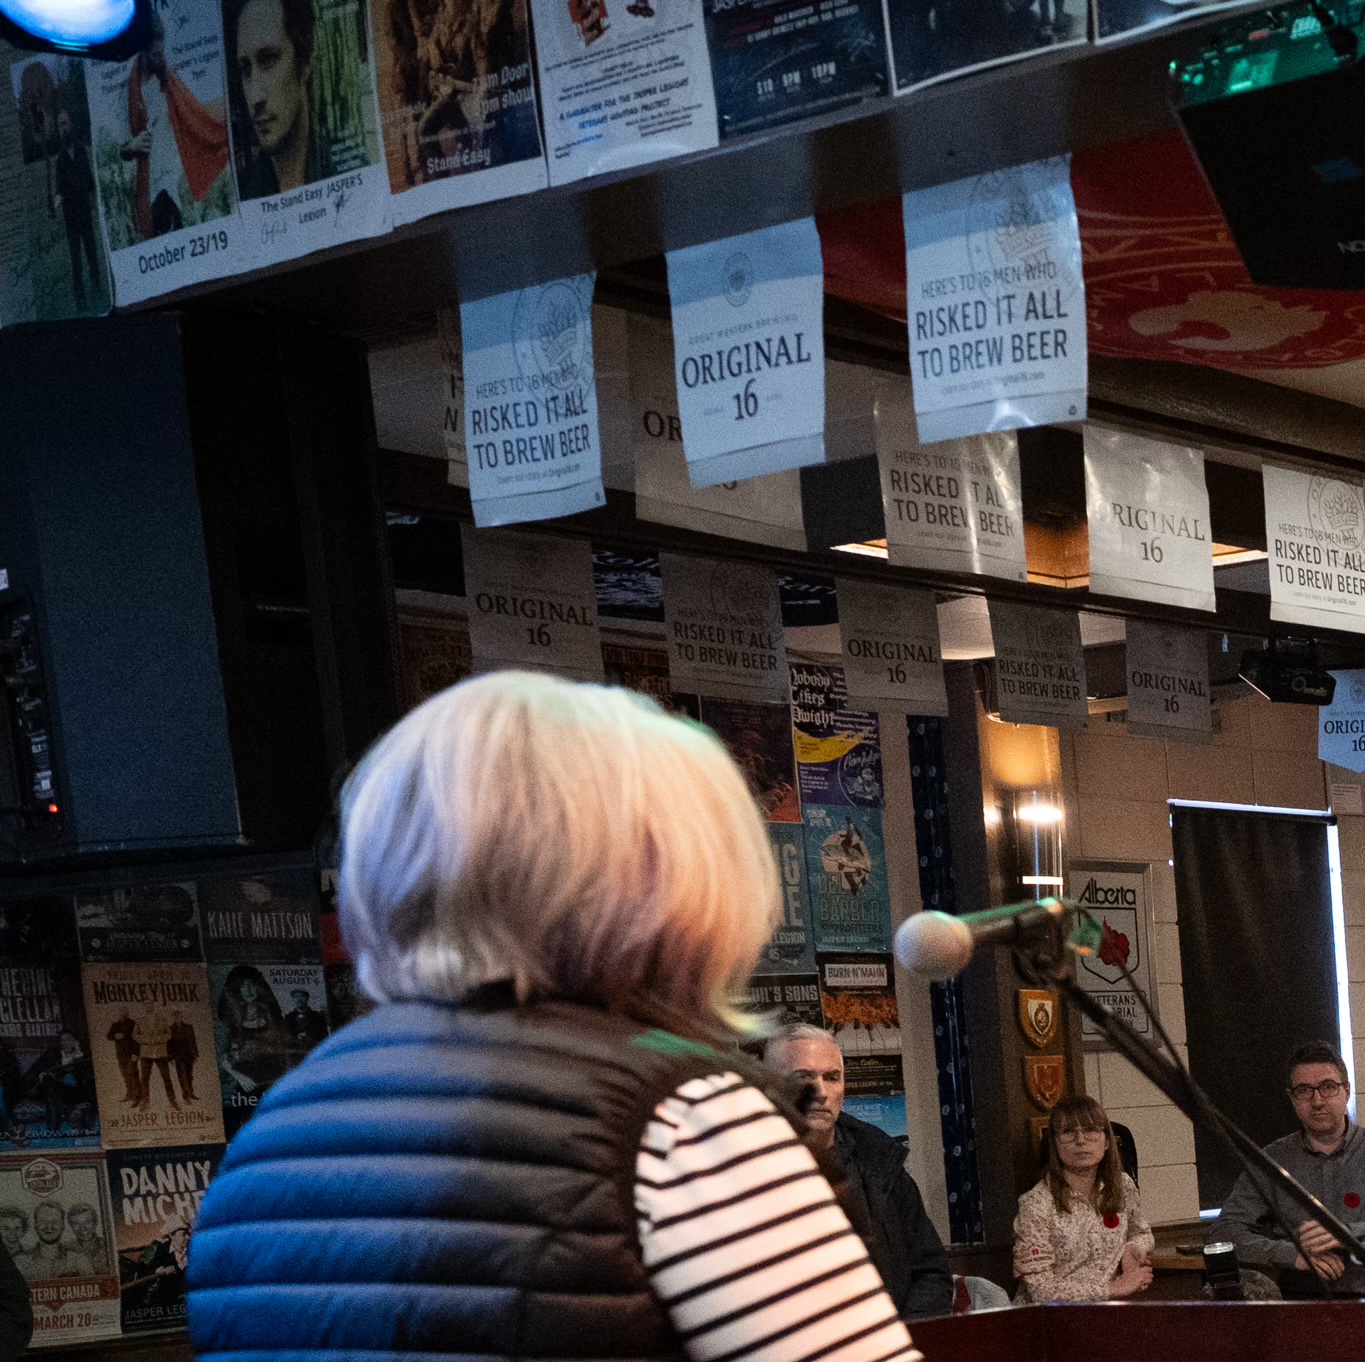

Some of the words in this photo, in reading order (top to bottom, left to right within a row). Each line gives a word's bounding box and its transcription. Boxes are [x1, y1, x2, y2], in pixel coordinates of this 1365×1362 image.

[427, 154, 458, 175] Stand
[459, 148, 492, 168] Easy
[260, 200, 278, 213] The
[304, 188, 323, 205] Easy
[326, 176, 364, 199] JASPER'S
[138, 245, 186, 275] October
[188, 230, 229, 258] 23/19
[915, 300, 987, 340] RISKED
[994, 294, 1016, 326] IT
[1023, 289, 1068, 321] ALL
[681, 332, 812, 389] ORIGINAL
[918, 348, 943, 380] TO
[949, 338, 1003, 374] BREW
[1011, 329, 1068, 363] BEER
[733, 377, 759, 421] 16
[473, 443, 499, 470] TO
[503, 432, 556, 466] BREW
[560, 425, 591, 456] BEER
[890, 469, 960, 499] RISKED
[1140, 537, 1164, 563] 16
[1274, 538, 1322, 565] RISKED
[1326, 548, 1339, 568] IT
[1343, 550, 1365, 573] ALL
[1276, 563, 1294, 584] TO
[1298, 566, 1333, 591] BREW
[475, 592, 594, 627] ORIGINAL
[847, 639, 937, 664] ORIGINAL
[1131, 670, 1206, 698] ORIGINAL
[792, 706, 834, 729] Dwight
[1078, 877, 1137, 906] Alberta
[249, 911, 314, 939] MATTSON
[819, 900, 882, 923] BARBER
[773, 932, 806, 945] LEGION
[268, 967, 320, 979] SATURDAY
[272, 976, 312, 986] AUGUST
[784, 985, 819, 1002] SONS
[230, 1091, 256, 1108] the
[120, 1110, 158, 1128] JASPER
[164, 1109, 206, 1125] LEGION
[119, 1159, 212, 1196] DANNY
[60, 1284, 101, 1301] CANADA
[33, 1315, 75, 1332] MARCH
[76, 1313, 92, 1328] 20
[124, 1304, 164, 1322] JASPER
